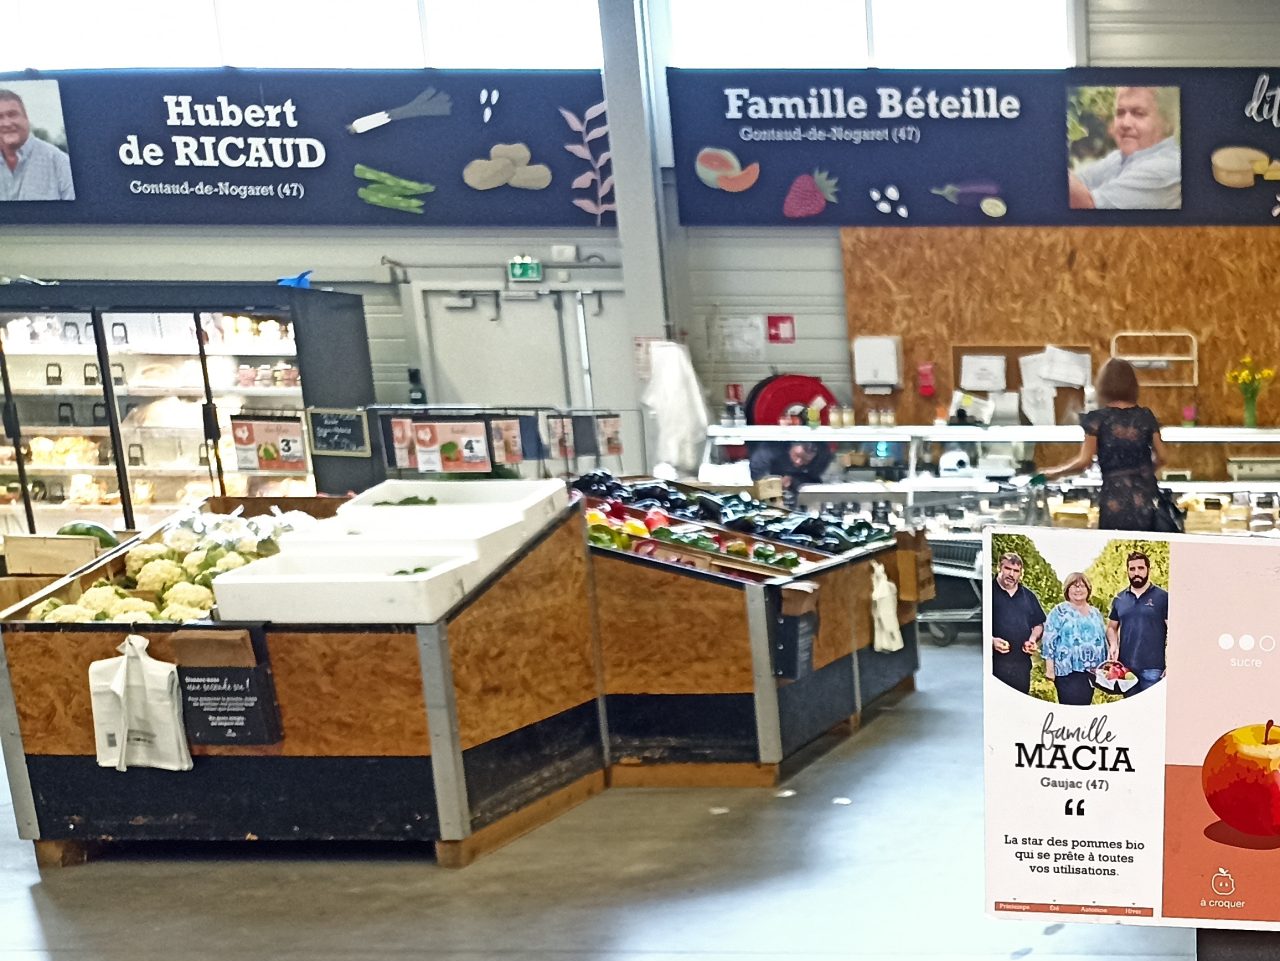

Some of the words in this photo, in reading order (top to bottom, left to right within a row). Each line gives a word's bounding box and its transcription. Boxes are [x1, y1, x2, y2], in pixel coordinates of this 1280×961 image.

[163, 95, 298, 128] Hubert
[723, 87, 868, 119] Famille
[877, 86, 1021, 119] Béteille
[118, 135, 164, 166] de
[171, 136, 326, 168] RICAUD
[129, 180, 275, 199] Gontaud-de-Nogaret
[277, 182, 305, 199] (47)
[1041, 712, 1117, 750] famille
[1015, 743, 1135, 772] MACIA
[1040, 777, 1082, 790] Gaujac
[1086, 779, 1109, 791] (47)
[1004, 834, 1018, 845] La
[1021, 836, 1043, 846] star
[1046, 836, 1068, 847] des
[1071, 839, 1122, 849] pommes
[1125, 839, 1145, 850] bio
[1015, 849, 1034, 861] qui
[1037, 851, 1050, 859] se
[1053, 851, 1085, 862] prête
[1088, 852, 1095, 862] à
[1098, 853, 1134, 863] toutes
[1029, 865, 1050, 873] vos
[1053, 864, 1119, 876] utilisations.
[1200, 898, 1206, 907] à
[1208, 898, 1246, 909] croquer
